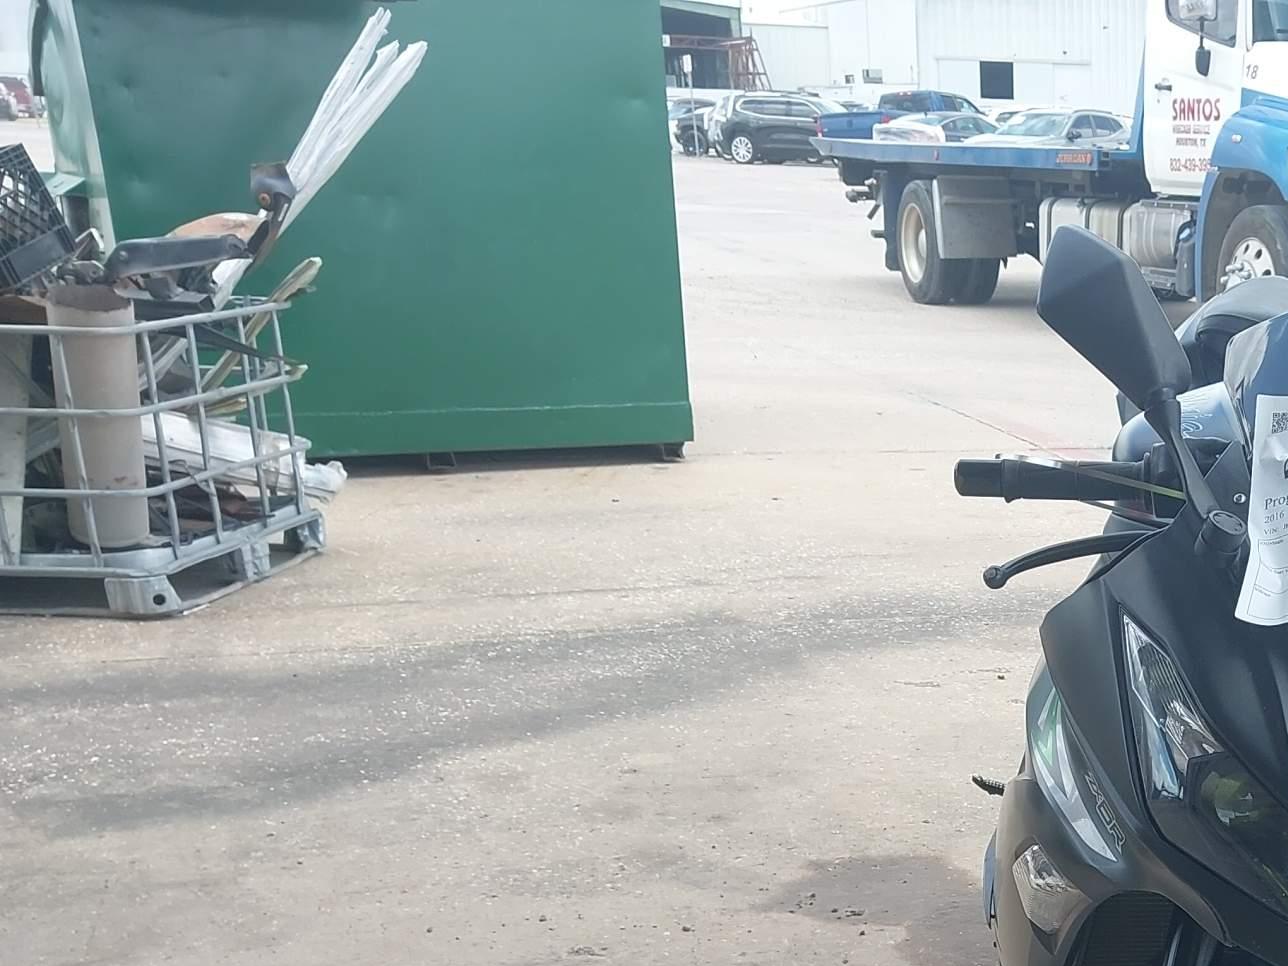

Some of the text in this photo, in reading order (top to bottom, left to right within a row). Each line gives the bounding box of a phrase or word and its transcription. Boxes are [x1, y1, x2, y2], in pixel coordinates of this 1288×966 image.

[1246, 64, 1259, 79] 18
[1172, 98, 1221, 121] SANTOS
[1264, 511, 1285, 524] 2016
